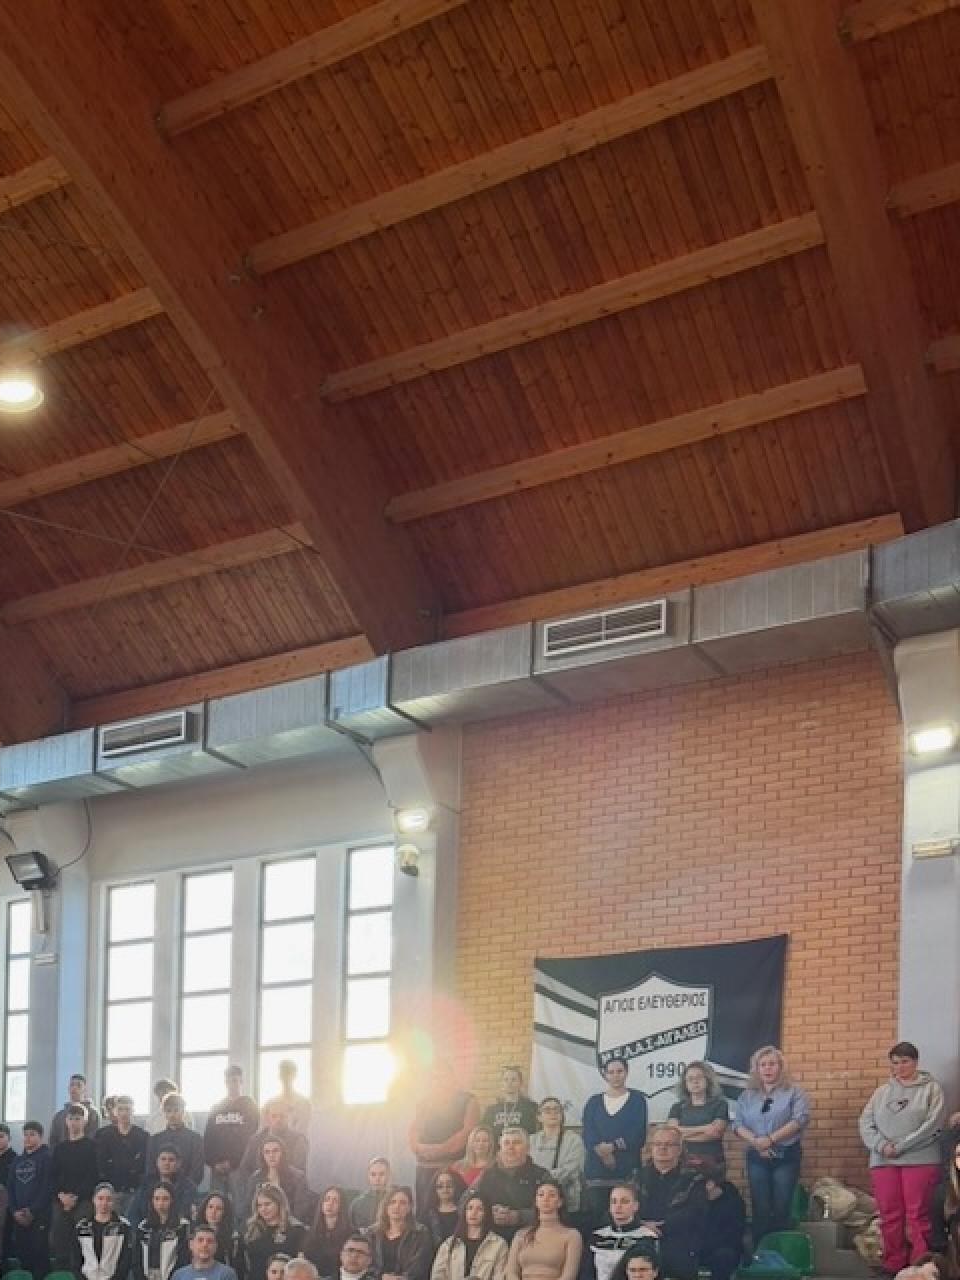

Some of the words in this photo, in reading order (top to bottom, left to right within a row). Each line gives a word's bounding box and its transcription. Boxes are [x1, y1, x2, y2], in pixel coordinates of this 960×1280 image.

[603, 997, 635, 1014] ΑΓΙΟΣ
[639, 992, 706, 1010] ΕΛΕΥΘΕΡΙΟΣ
[647, 1062, 685, 1079] 1990
